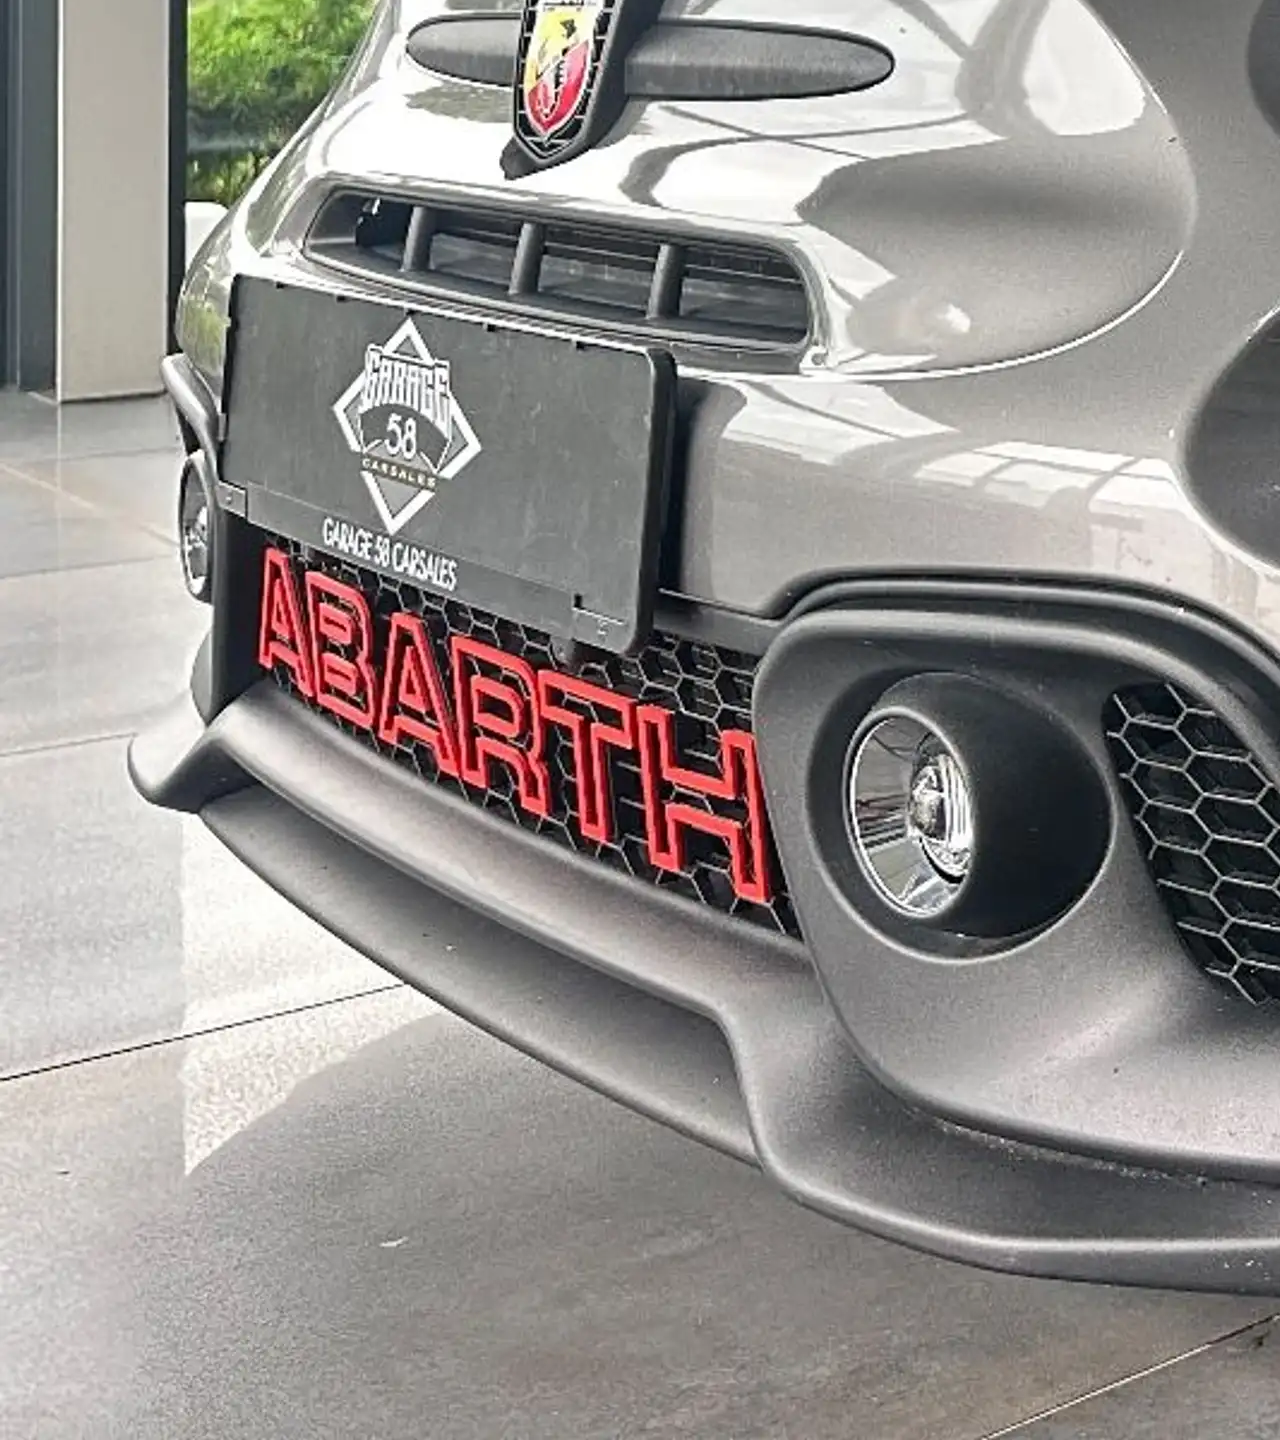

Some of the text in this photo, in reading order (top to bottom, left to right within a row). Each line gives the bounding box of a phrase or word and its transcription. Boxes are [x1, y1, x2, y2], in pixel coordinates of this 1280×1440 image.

[361, 344, 450, 441] GARAGE
[361, 458, 437, 489] CARSALES
[384, 413, 418, 460] 58
[322, 516, 459, 593] GARAGE 58 CARSALES
[258, 546, 771, 904] ABARTH
